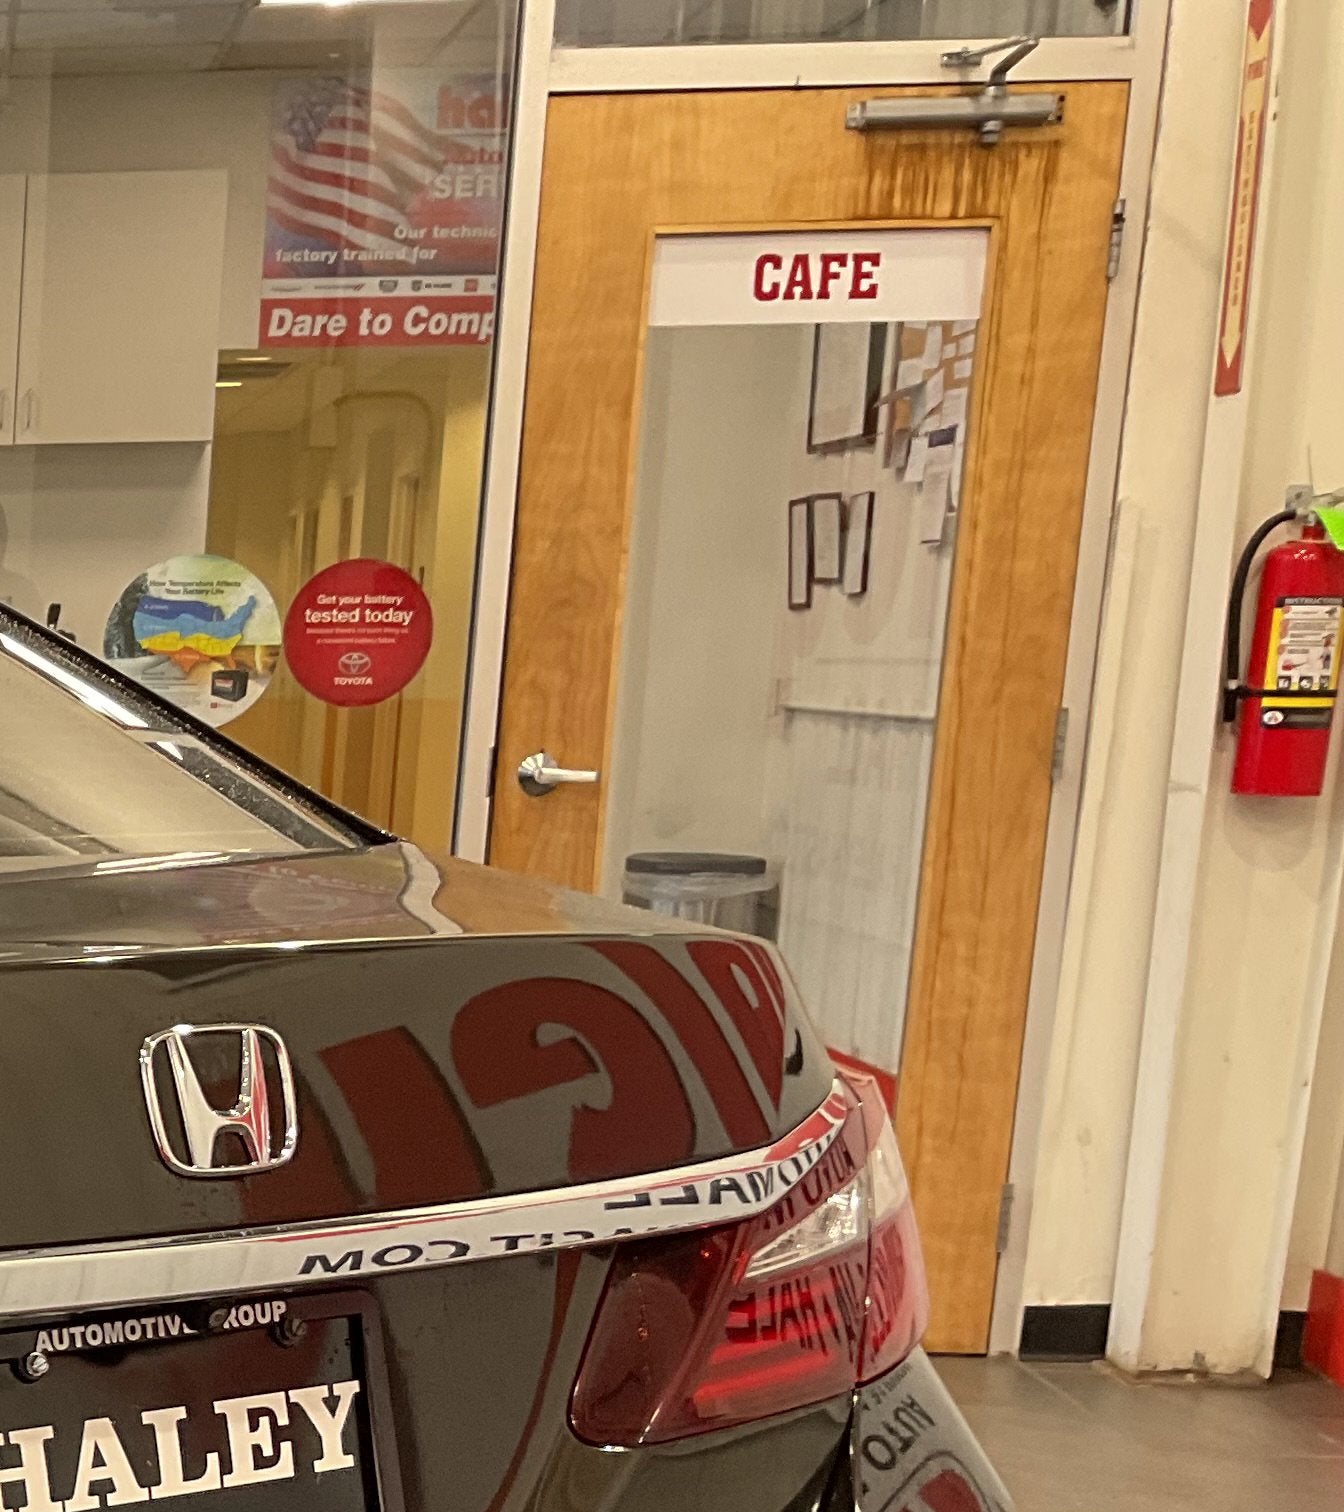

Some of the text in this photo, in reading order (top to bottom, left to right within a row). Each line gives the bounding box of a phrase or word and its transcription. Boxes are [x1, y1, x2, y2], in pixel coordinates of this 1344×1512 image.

[394, 226, 427, 239] Our
[275, 246, 438, 264] factory trained for
[752, 251, 882, 302] CAFE
[268, 307, 348, 337] Dare
[358, 307, 393, 335] to
[317, 594, 405, 606] Get your battery
[305, 608, 414, 625] tested today
[334, 677, 373, 686] TOYOTA
